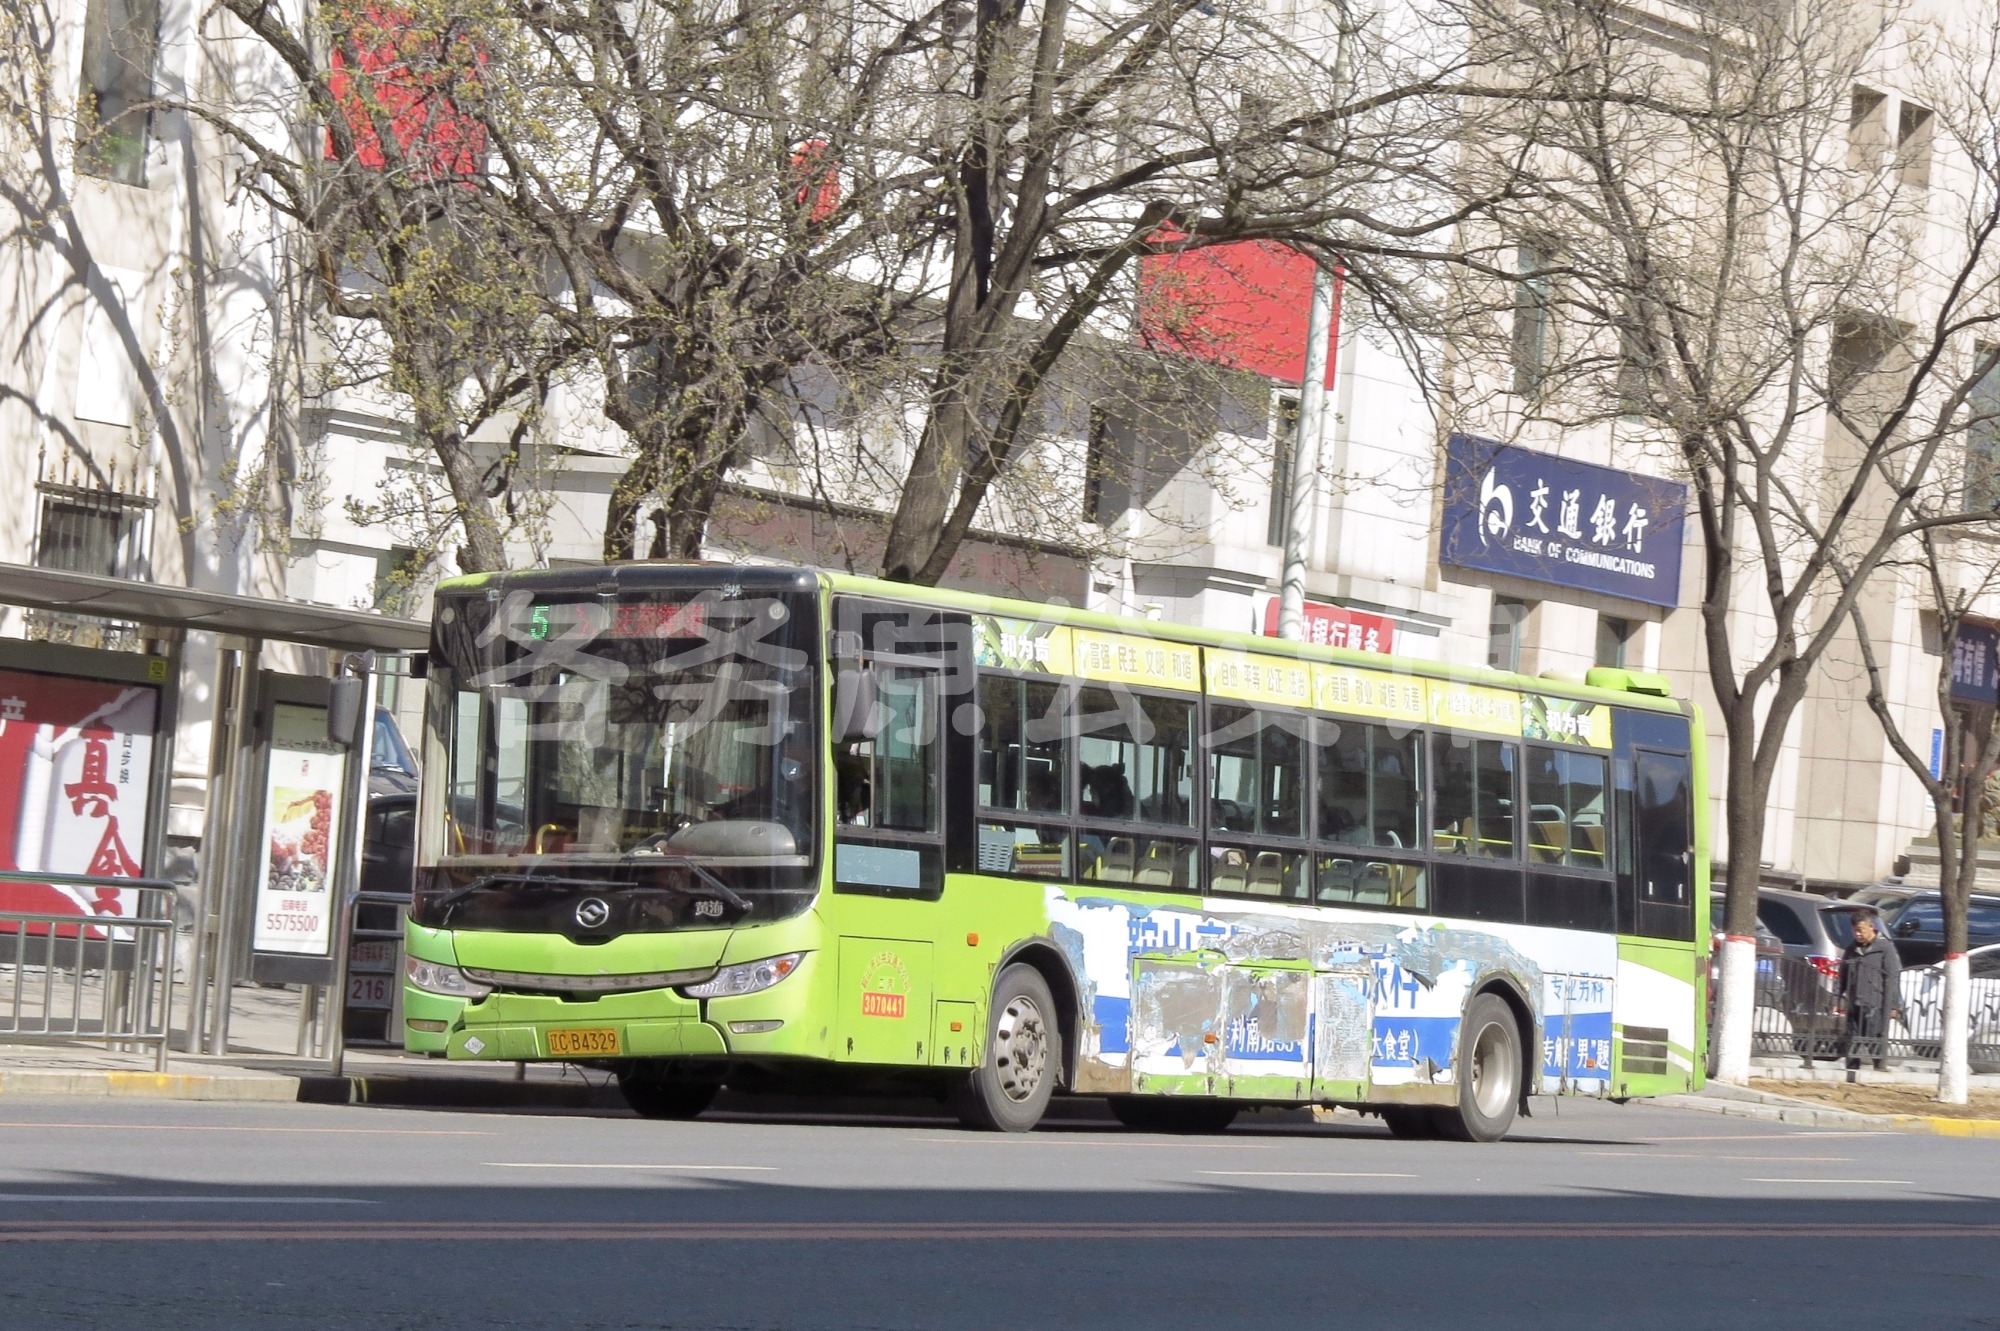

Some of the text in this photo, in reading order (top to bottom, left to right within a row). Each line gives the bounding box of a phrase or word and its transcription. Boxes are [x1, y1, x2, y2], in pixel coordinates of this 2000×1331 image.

[1526, 478, 1649, 553] 交通銀行
[1513, 536, 1655, 579] BANK OF COMMUNICATIONS
[530, 605, 549, 639] 5
[1000, 633, 1049, 661] 和为贵
[1090, 641, 1192, 680] 富强 民主 文明 和谐
[1221, 661, 1305, 697] 自由 平等 公正 法治
[1331, 676, 1420, 712] 爱国 敬业 诚信 友善
[1545, 709, 1591, 737] 和为贵
[266, 913, 318, 931] 5575500
[695, 900, 724, 917] 黄海
[352, 979, 384, 1000] 216
[1550, 970, 1604, 1003] 专业男科
[864, 995, 903, 1015] 3070441
